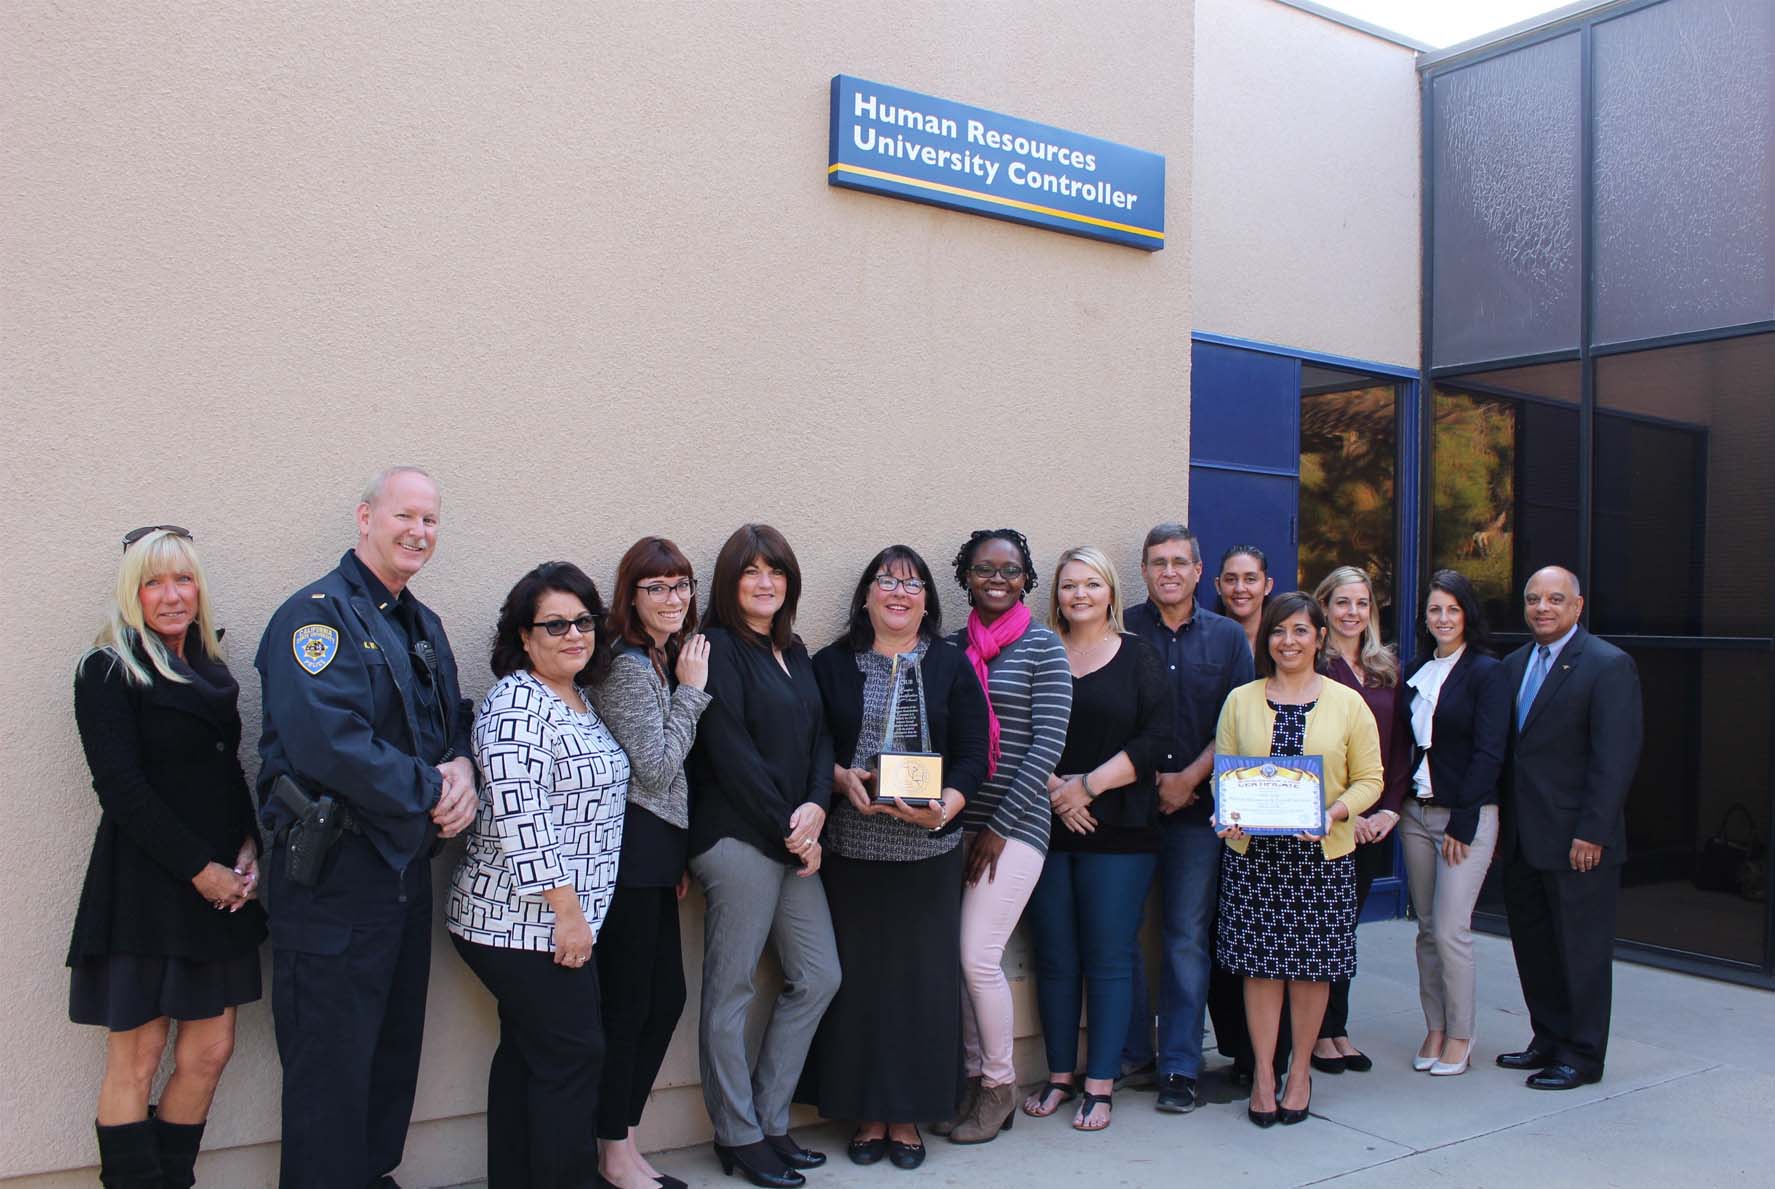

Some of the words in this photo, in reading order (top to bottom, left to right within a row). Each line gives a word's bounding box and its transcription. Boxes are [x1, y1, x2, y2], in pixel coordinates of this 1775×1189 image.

[853, 92, 958, 138] Human
[967, 119, 1097, 172] Resources
[853, 125, 1000, 185] University
[1008, 161, 1138, 211] Controller
[298, 626, 333, 636] CALIFORNIA
